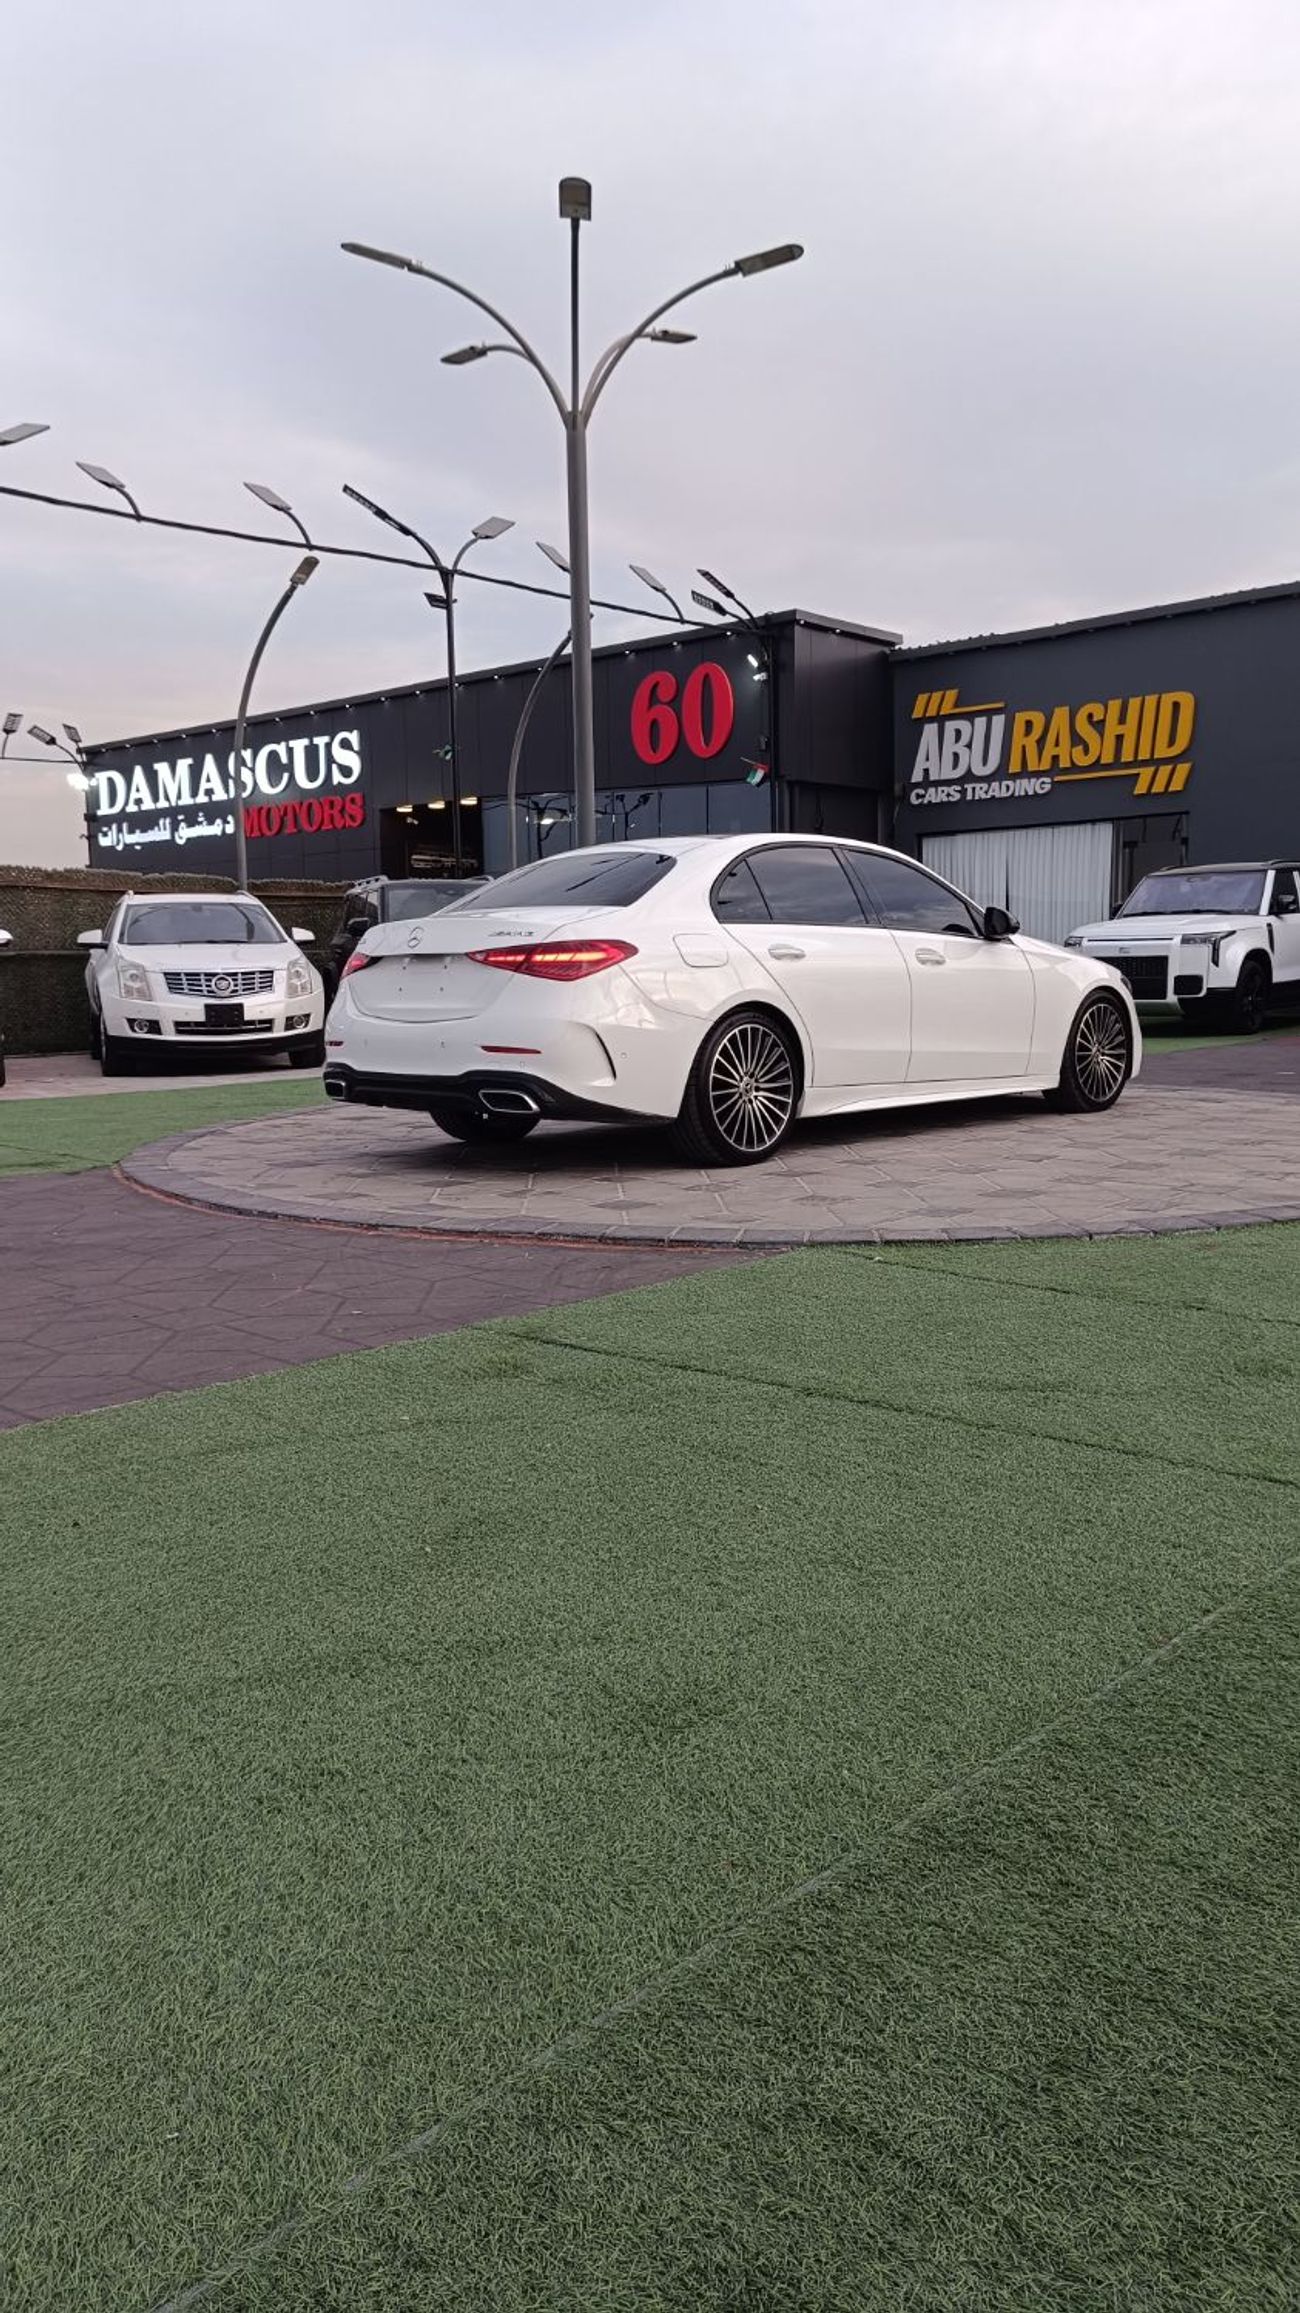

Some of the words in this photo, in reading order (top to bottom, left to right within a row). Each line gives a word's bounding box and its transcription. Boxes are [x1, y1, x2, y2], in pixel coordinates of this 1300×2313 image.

[631, 661, 735, 765] 60
[911, 714, 1006, 783] ABU
[1008, 690, 1196, 774] RASHID
[94, 729, 363, 816] DAMASCUS
[909, 783, 962, 805] CARS
[963, 776, 1053, 800] TRADING
[97, 817, 173, 851] للسيارات
[174, 811, 236, 845] دمشق
